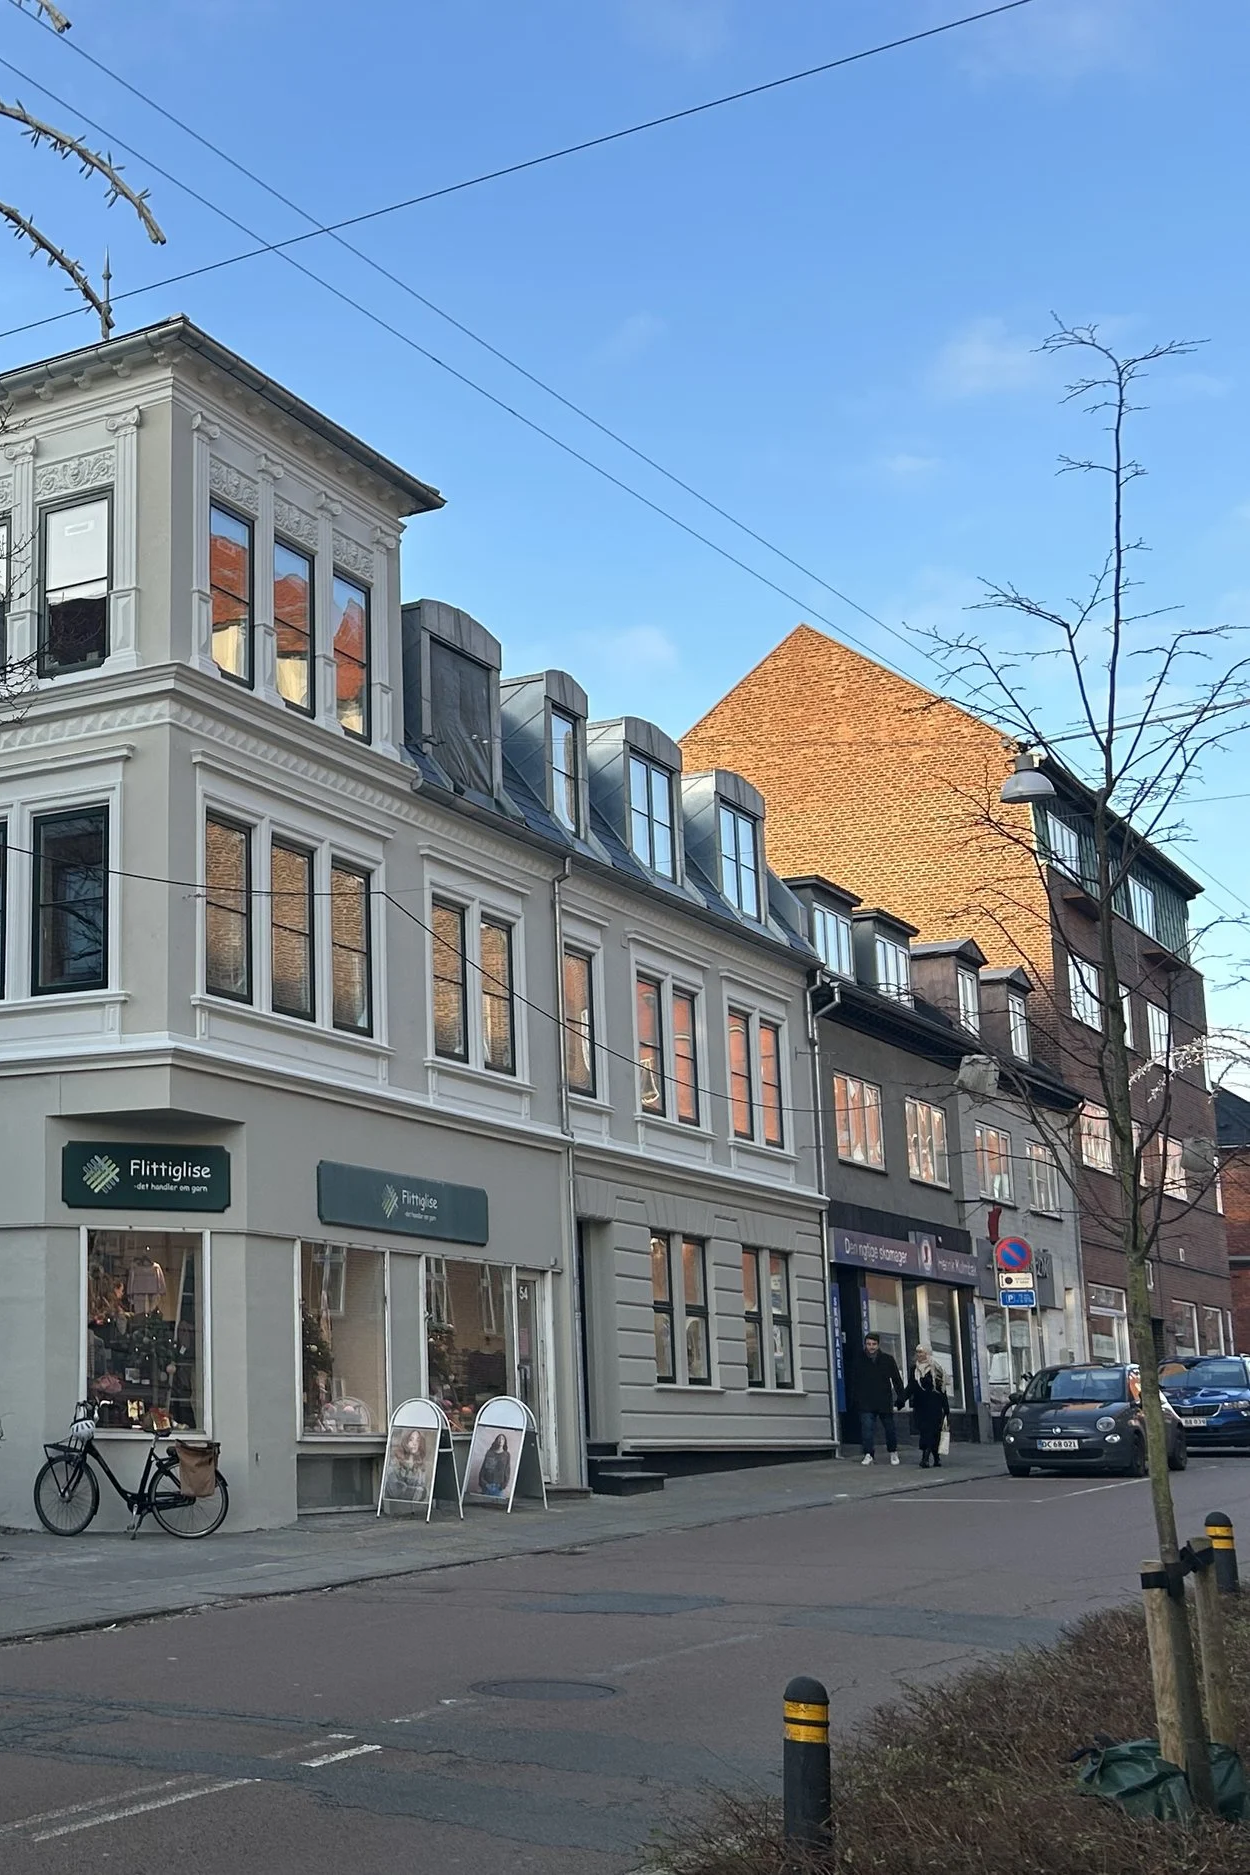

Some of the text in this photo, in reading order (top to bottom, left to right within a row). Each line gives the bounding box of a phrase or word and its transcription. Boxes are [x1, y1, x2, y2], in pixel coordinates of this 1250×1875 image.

[130, 1159, 212, 1182] Flittiglise
[151, 1183, 178, 1191] handler
[191, 1185, 208, 1194] garn
[402, 1189, 438, 1211] Flittiglise
[844, 1237, 858, 1254] Den
[519, 1286, 528, 1300] 54
[1062, 1440, 1076, 1448] 021
